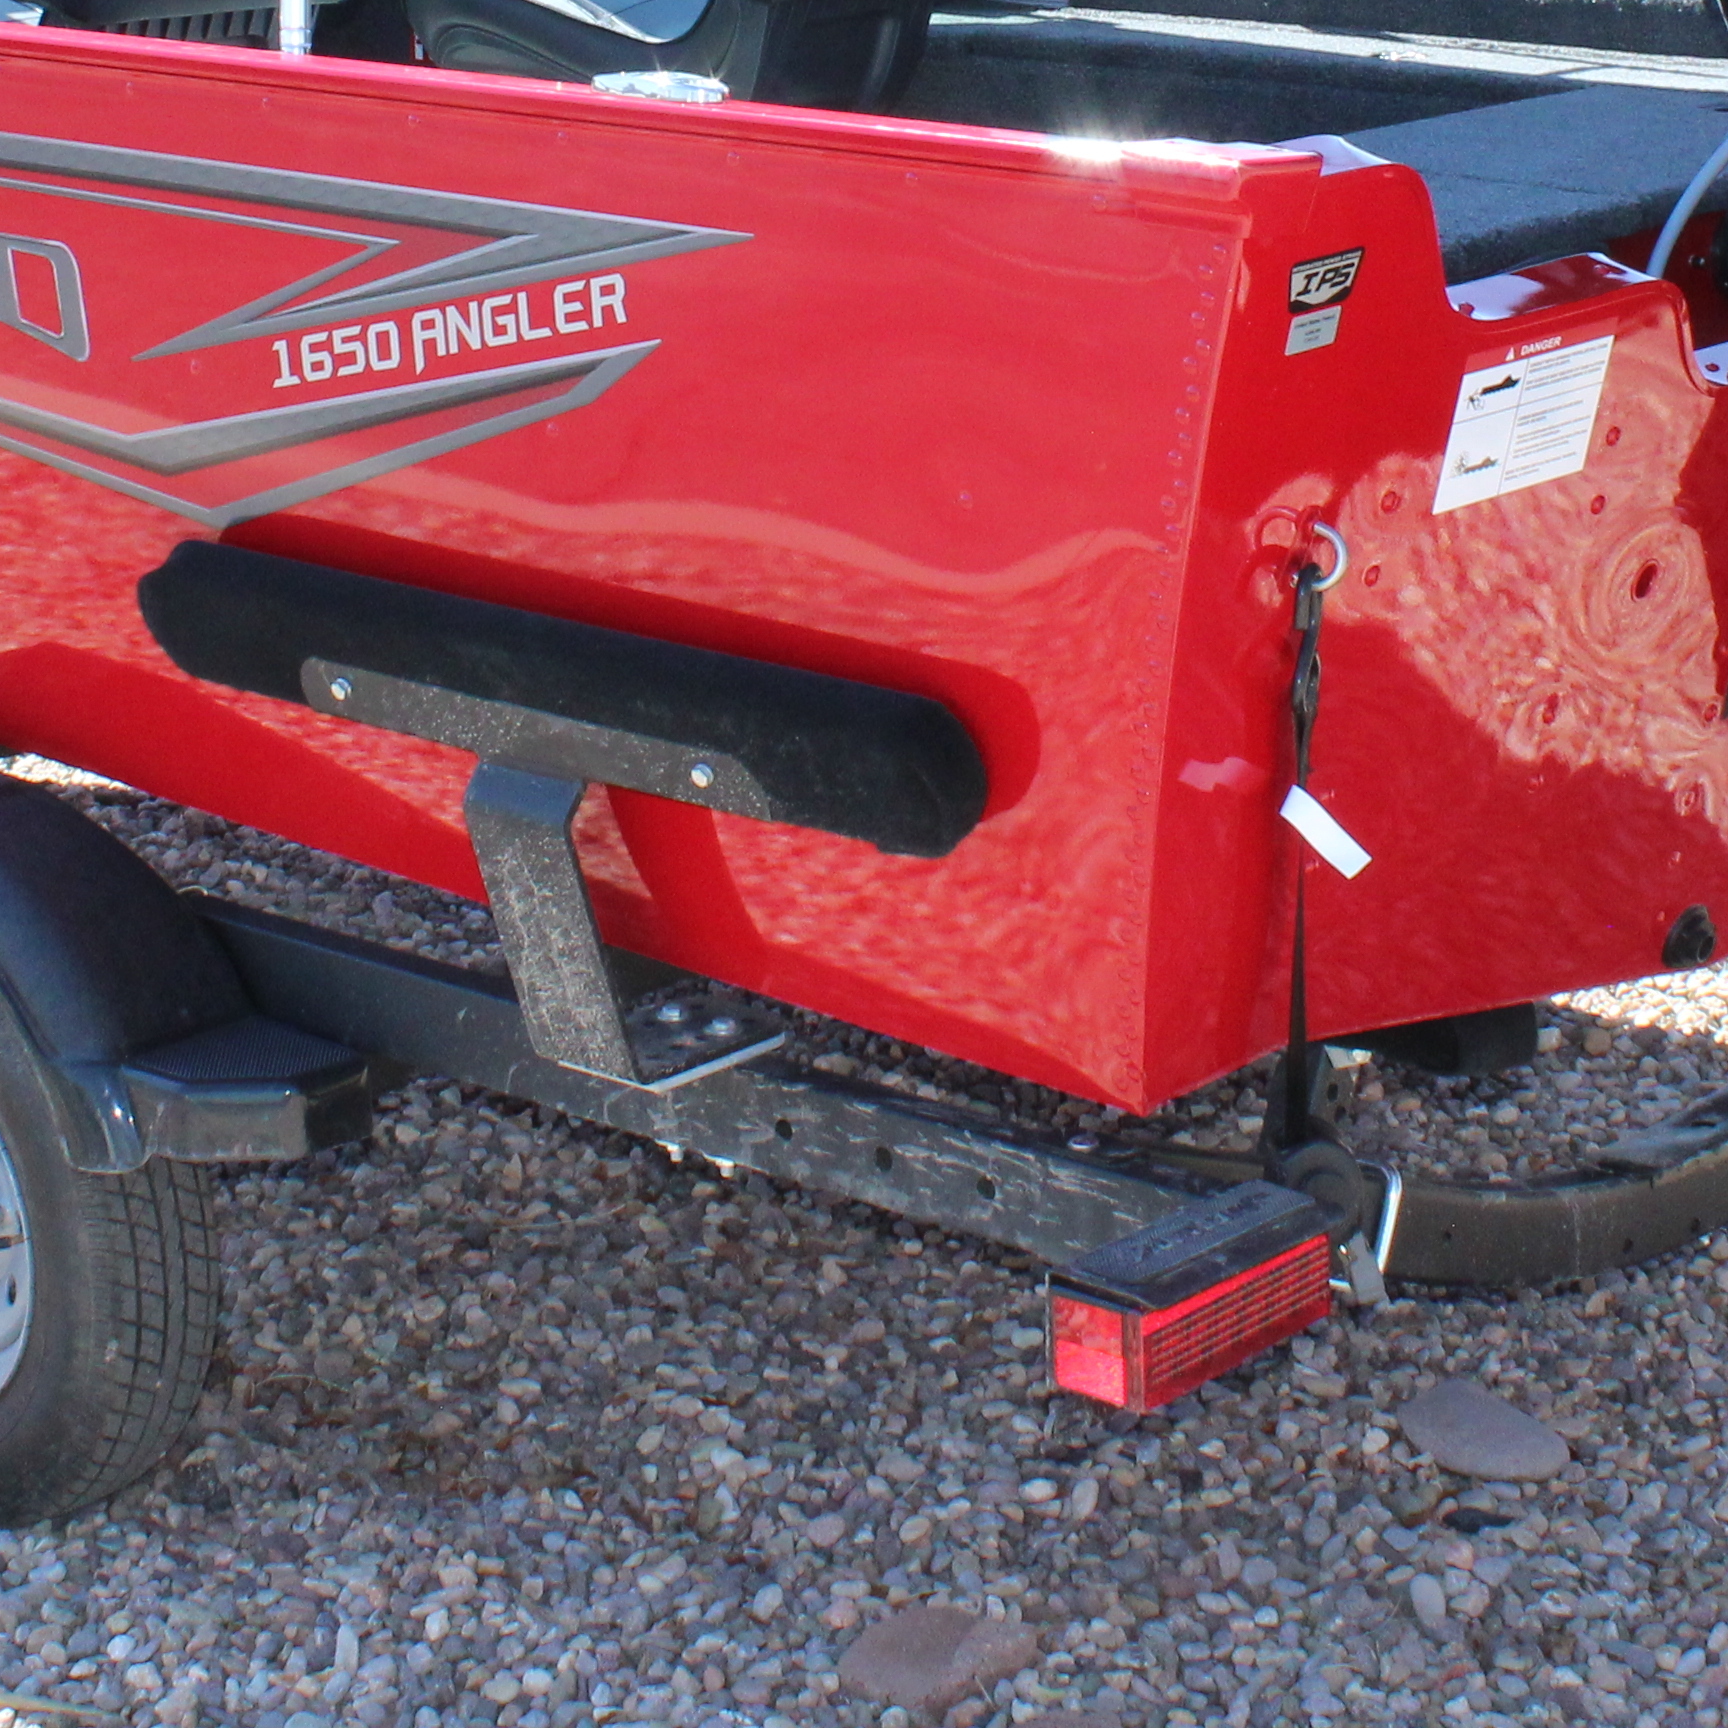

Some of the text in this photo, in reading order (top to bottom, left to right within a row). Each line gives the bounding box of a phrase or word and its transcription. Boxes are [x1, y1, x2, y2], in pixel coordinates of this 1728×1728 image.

[1295, 262, 1355, 297] IPS
[272, 273, 627, 388] 1650 ANGLER
[1520, 336, 1562, 356] DANGER
